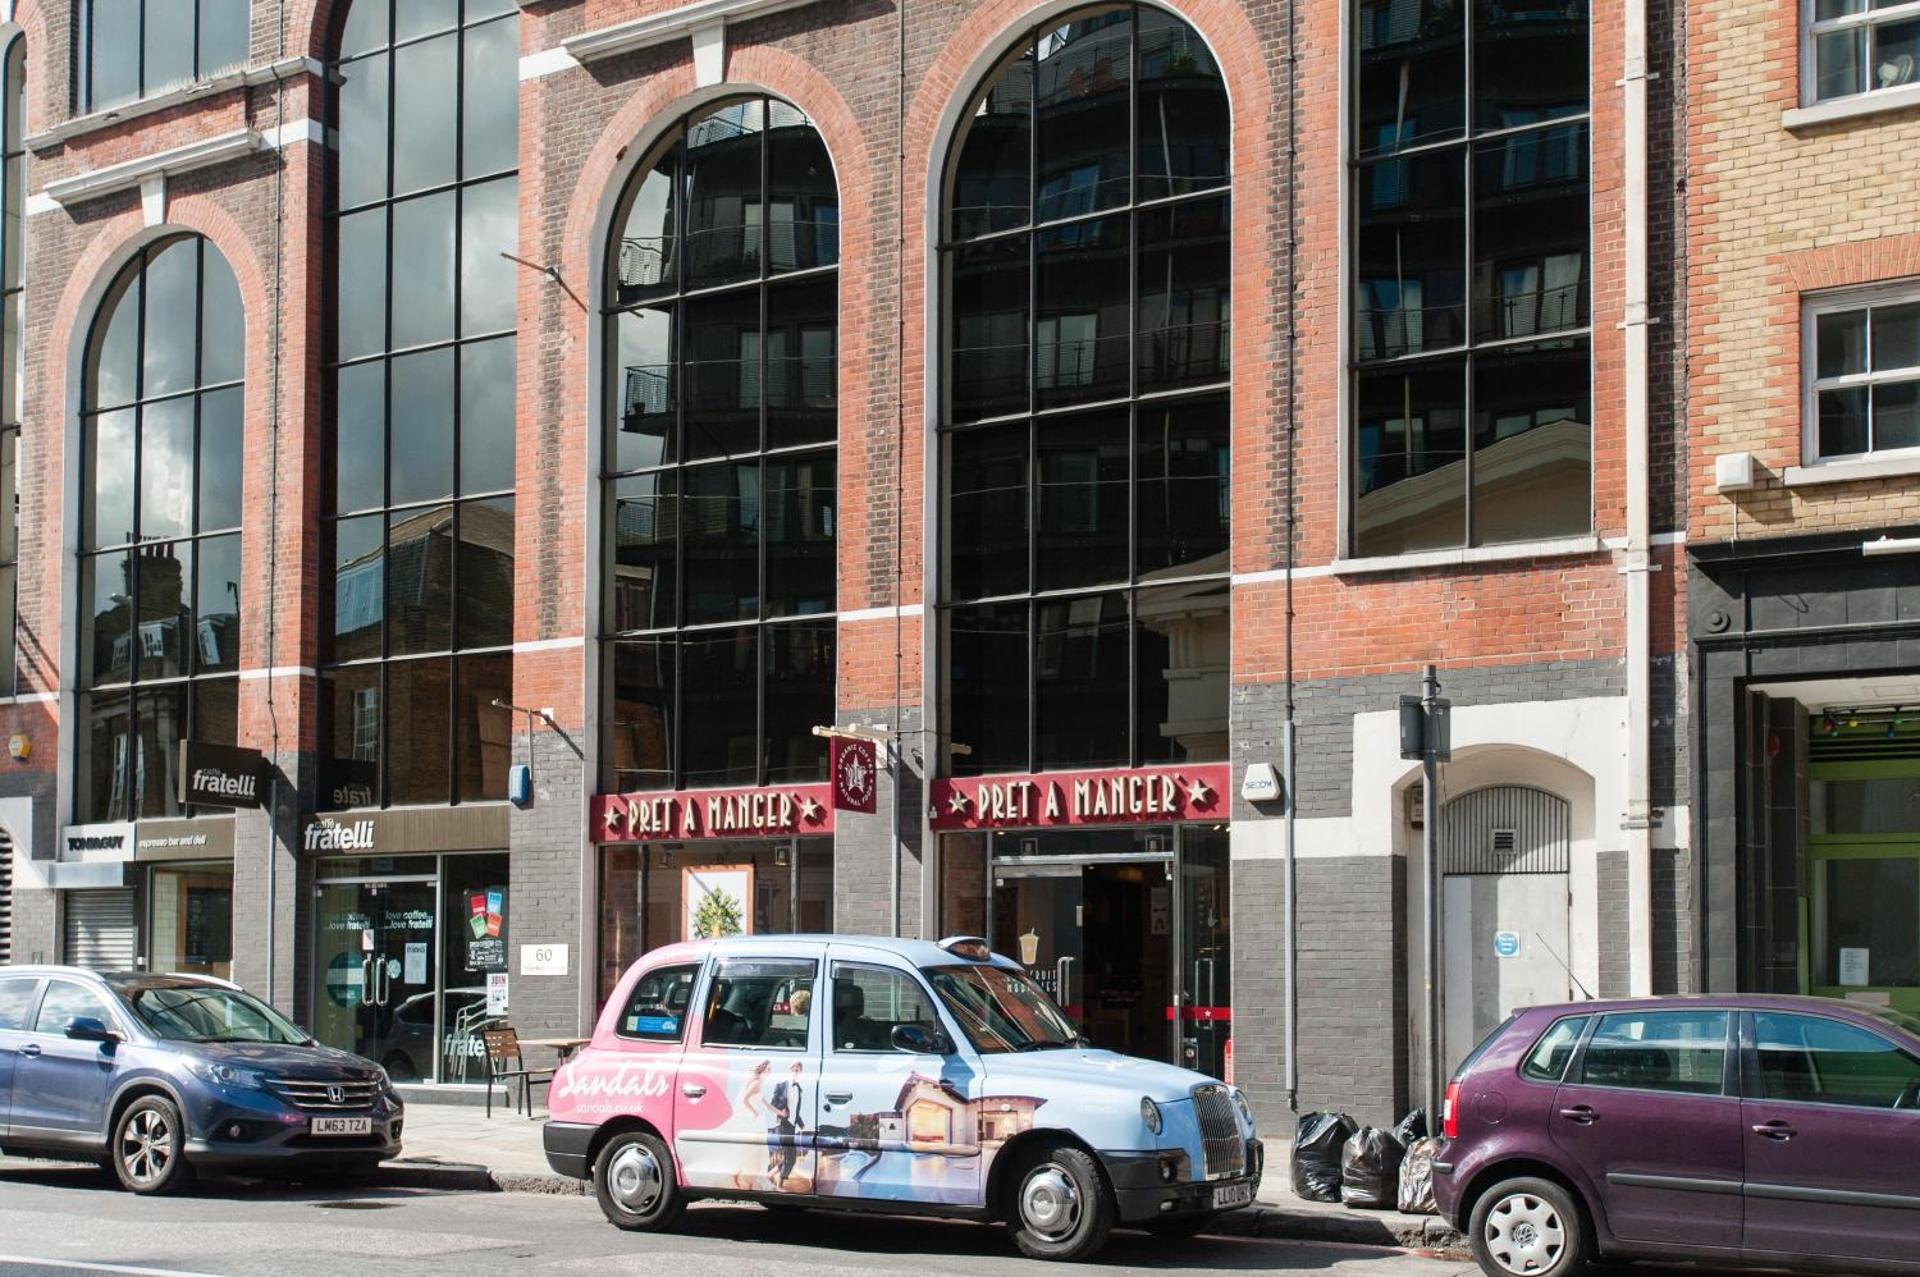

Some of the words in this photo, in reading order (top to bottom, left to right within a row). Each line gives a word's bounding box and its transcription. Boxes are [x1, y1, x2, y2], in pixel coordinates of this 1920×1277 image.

[193, 769, 256, 796] fratelli
[978, 781, 1032, 819] PRET
[1045, 781, 1059, 817] A
[1075, 775, 1176, 816] MANGER
[628, 798, 672, 832] PRET
[684, 798, 696, 831] A
[707, 792, 793, 829] MANGER
[305, 821, 375, 850] fratelli
[536, 949, 552, 961] 60
[444, 1033, 486, 1056] frate
[558, 1060, 670, 1098] Sandals
[317, 1119, 345, 1131] LM63
[349, 1119, 367, 1131] TZA
